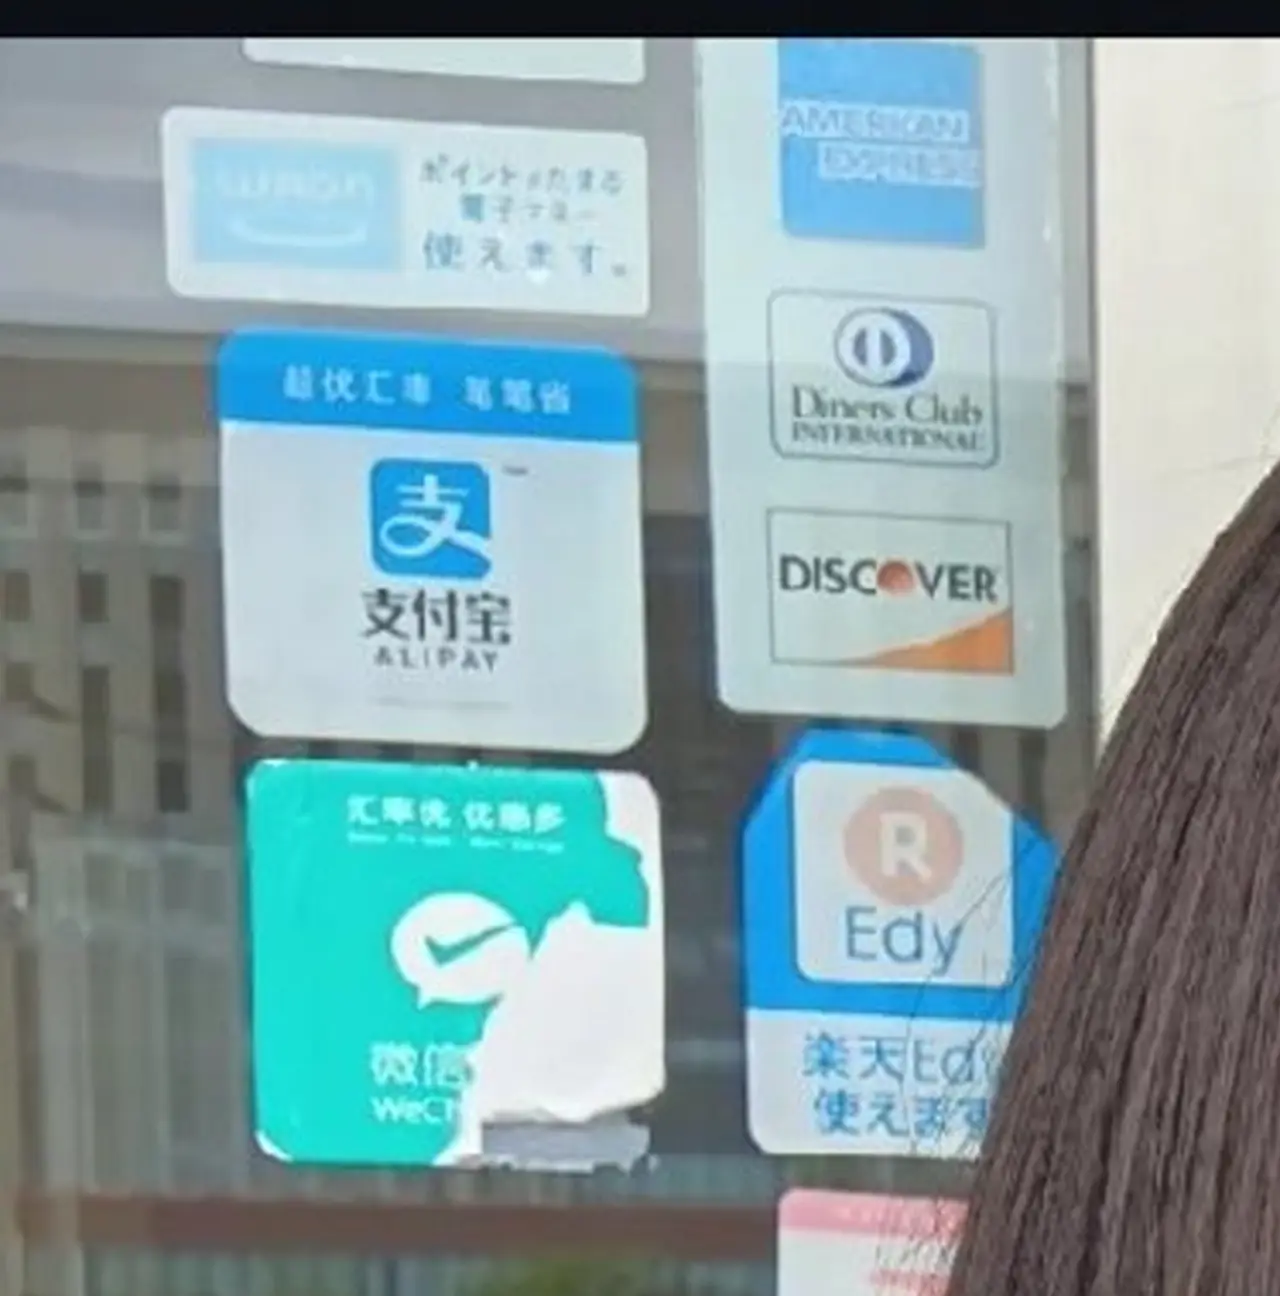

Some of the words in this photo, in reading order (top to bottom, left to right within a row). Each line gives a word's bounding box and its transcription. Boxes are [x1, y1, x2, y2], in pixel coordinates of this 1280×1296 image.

[792, 384, 896, 420] Diners
[905, 390, 984, 426] Club
[792, 421, 982, 452] INTERNATIONAL
[779, 553, 999, 603] DISCOVER
[361, 587, 513, 646] 支付宝
[374, 646, 500, 673] ALIPAY
[845, 905, 964, 976] Edy
